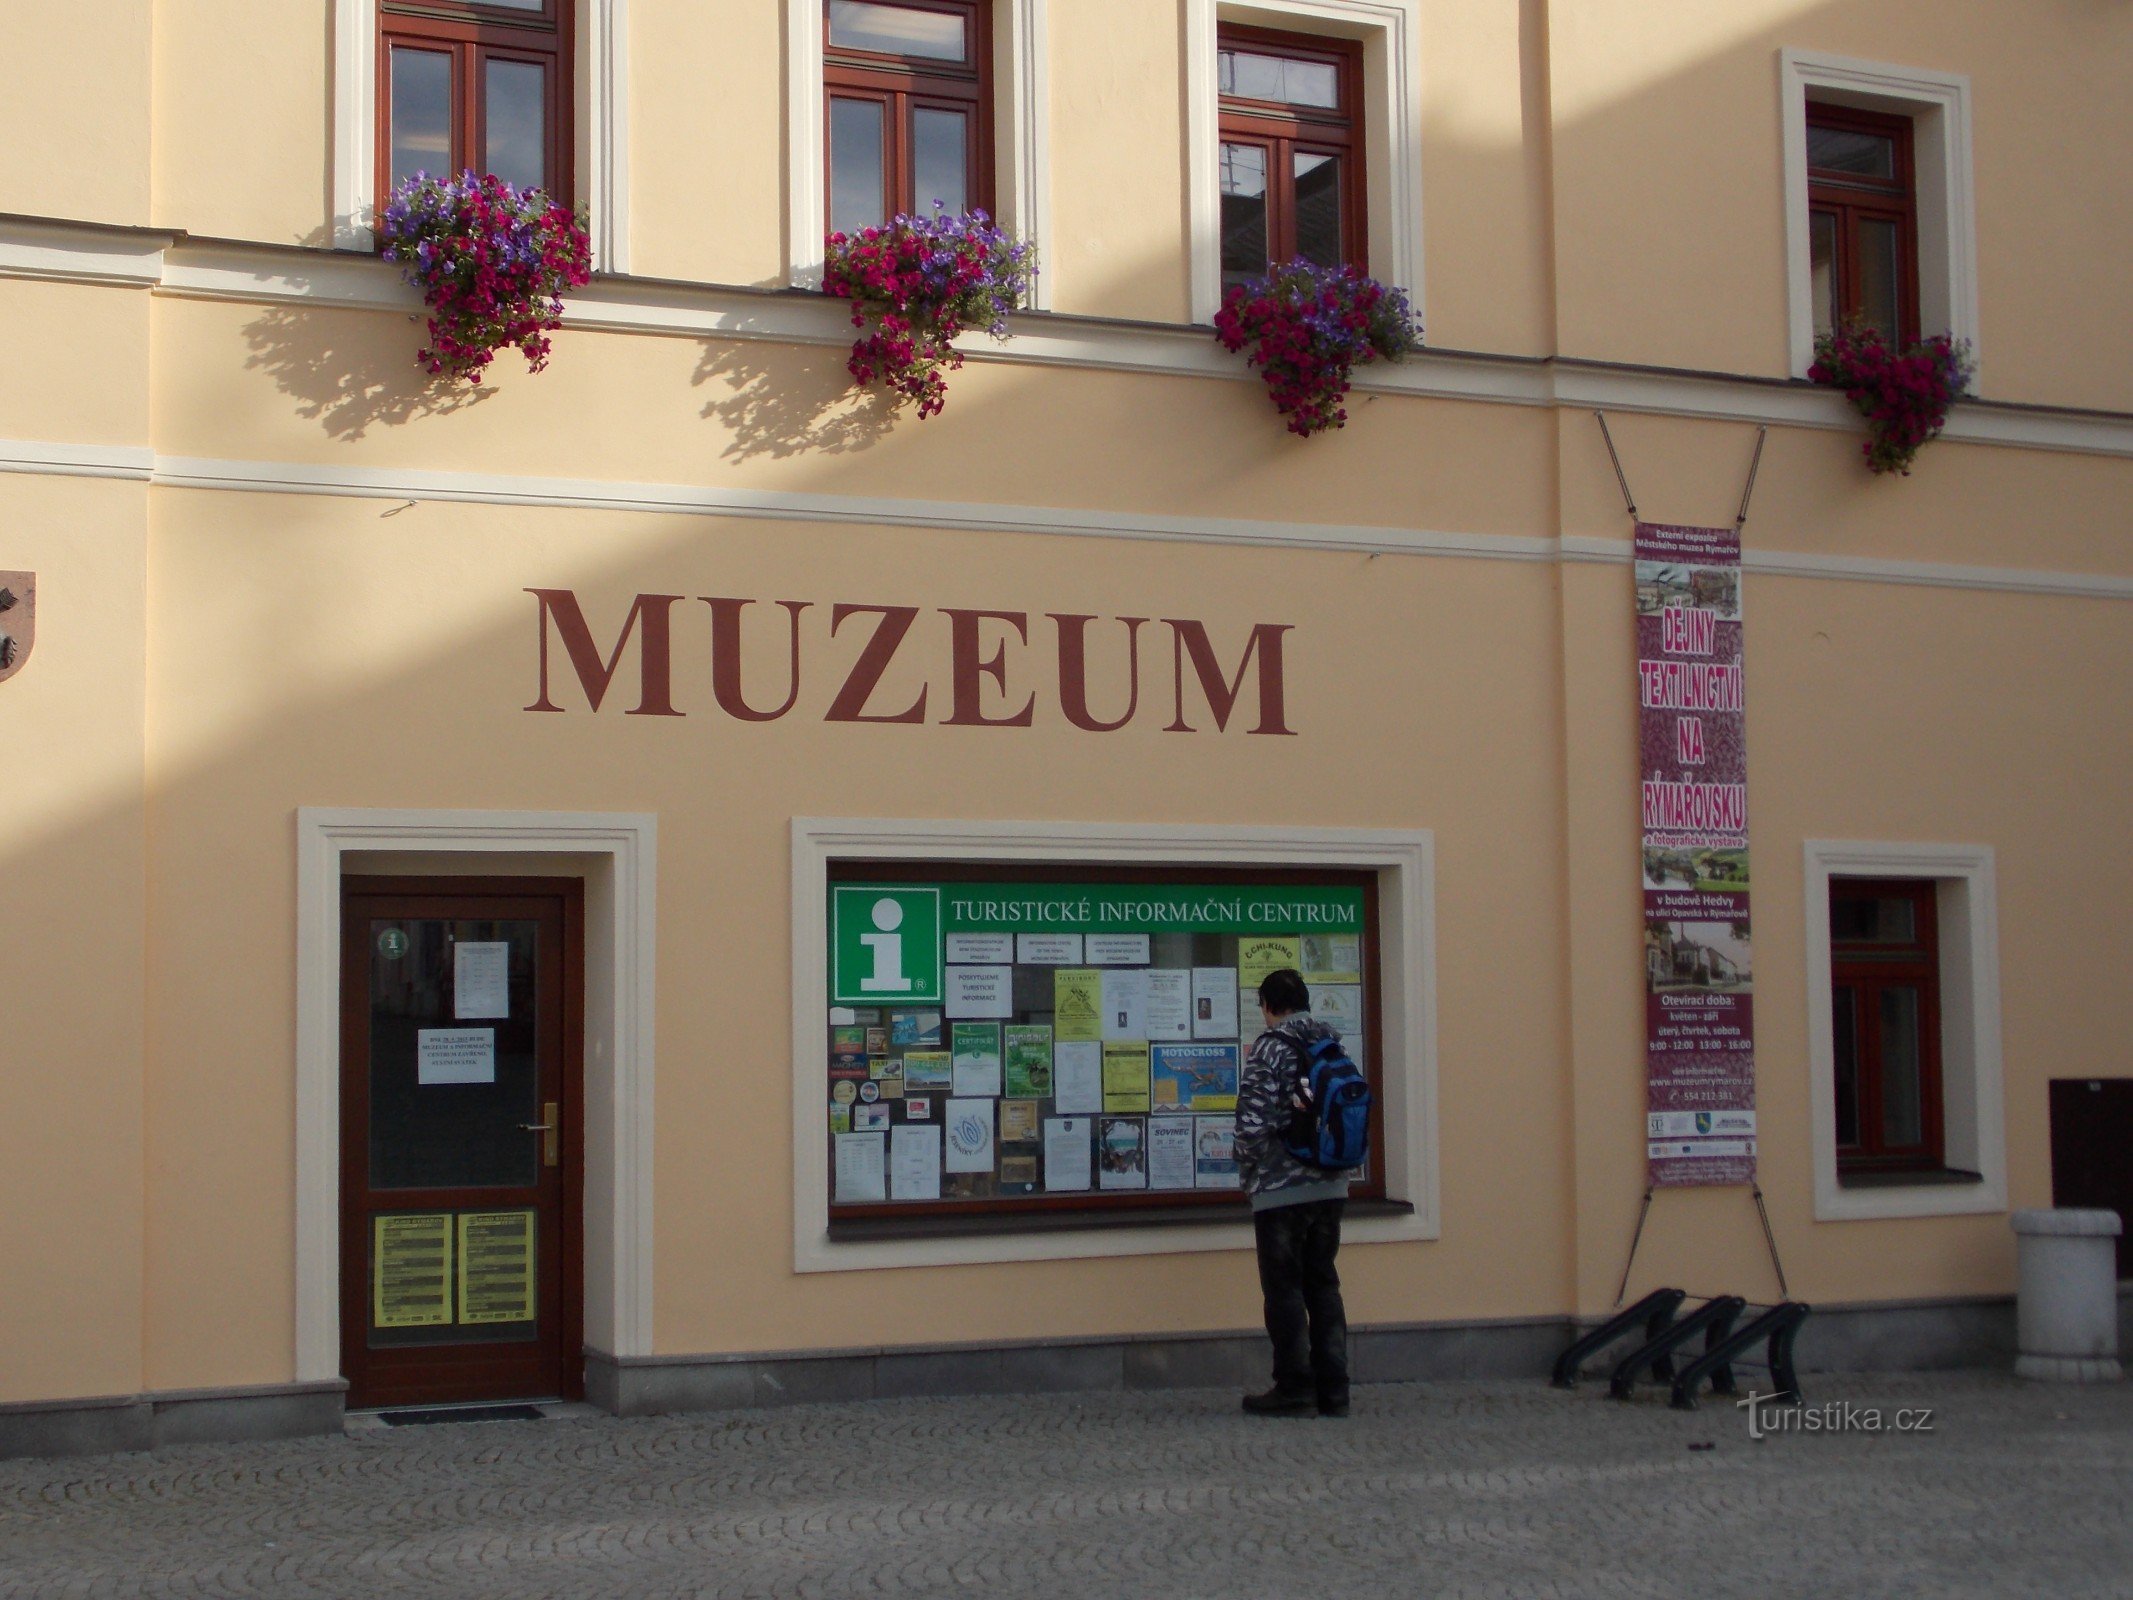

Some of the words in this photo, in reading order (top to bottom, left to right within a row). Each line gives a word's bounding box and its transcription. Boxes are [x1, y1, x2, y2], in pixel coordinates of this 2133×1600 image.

[1656, 530, 1684, 540] Externí
[1685, 533, 1718, 543] expozice
[1636, 538, 1678, 550] Městského
[1679, 543, 1704, 552] muzea
[1705, 544, 1738, 555] Rýmařov
[1663, 595, 1716, 655] DĚJINY
[523, 587, 1298, 735] MUZEUM
[1639, 654, 1742, 711] TEXTILNICTVÍ
[1677, 717, 1705, 764] NA
[1643, 770, 1746, 831] RÝMAŘOVSKU
[1653, 834, 1706, 847] fotografická
[1708, 836, 1744, 848] výstava
[1665, 894, 1700, 906] budově
[1703, 896, 1734, 908] Hedvy
[951, 897, 1091, 922] TURISTICKÉ
[1099, 897, 1241, 922] INFORMAČNÍ
[1248, 903, 1355, 923] CENTRUM
[961, 994, 996, 1002] INFORMACE
[1662, 994, 1704, 1006] Otevírací
[1706, 995, 1735, 1006] doba:
[1670, 1012, 1698, 1021] květen
[1703, 1012, 1719, 1021] září
[1713, 1026, 1740, 1036] sobota
[1650, 1041, 1667, 1051] 9:00
[1673, 1041, 1694, 1050] 12:00
[1700, 1040, 1722, 1050] 13:00
[1728, 1040, 1752, 1050] 16:00
[1161, 1048, 1226, 1057] MOTOCROSS
[1650, 1078, 1753, 1087] www.muzeumrymarov.cz
[1684, 1092, 1699, 1101] 554
[1701, 1092, 1716, 1100] 212
[1154, 1128, 1190, 1136] SOVINEC
